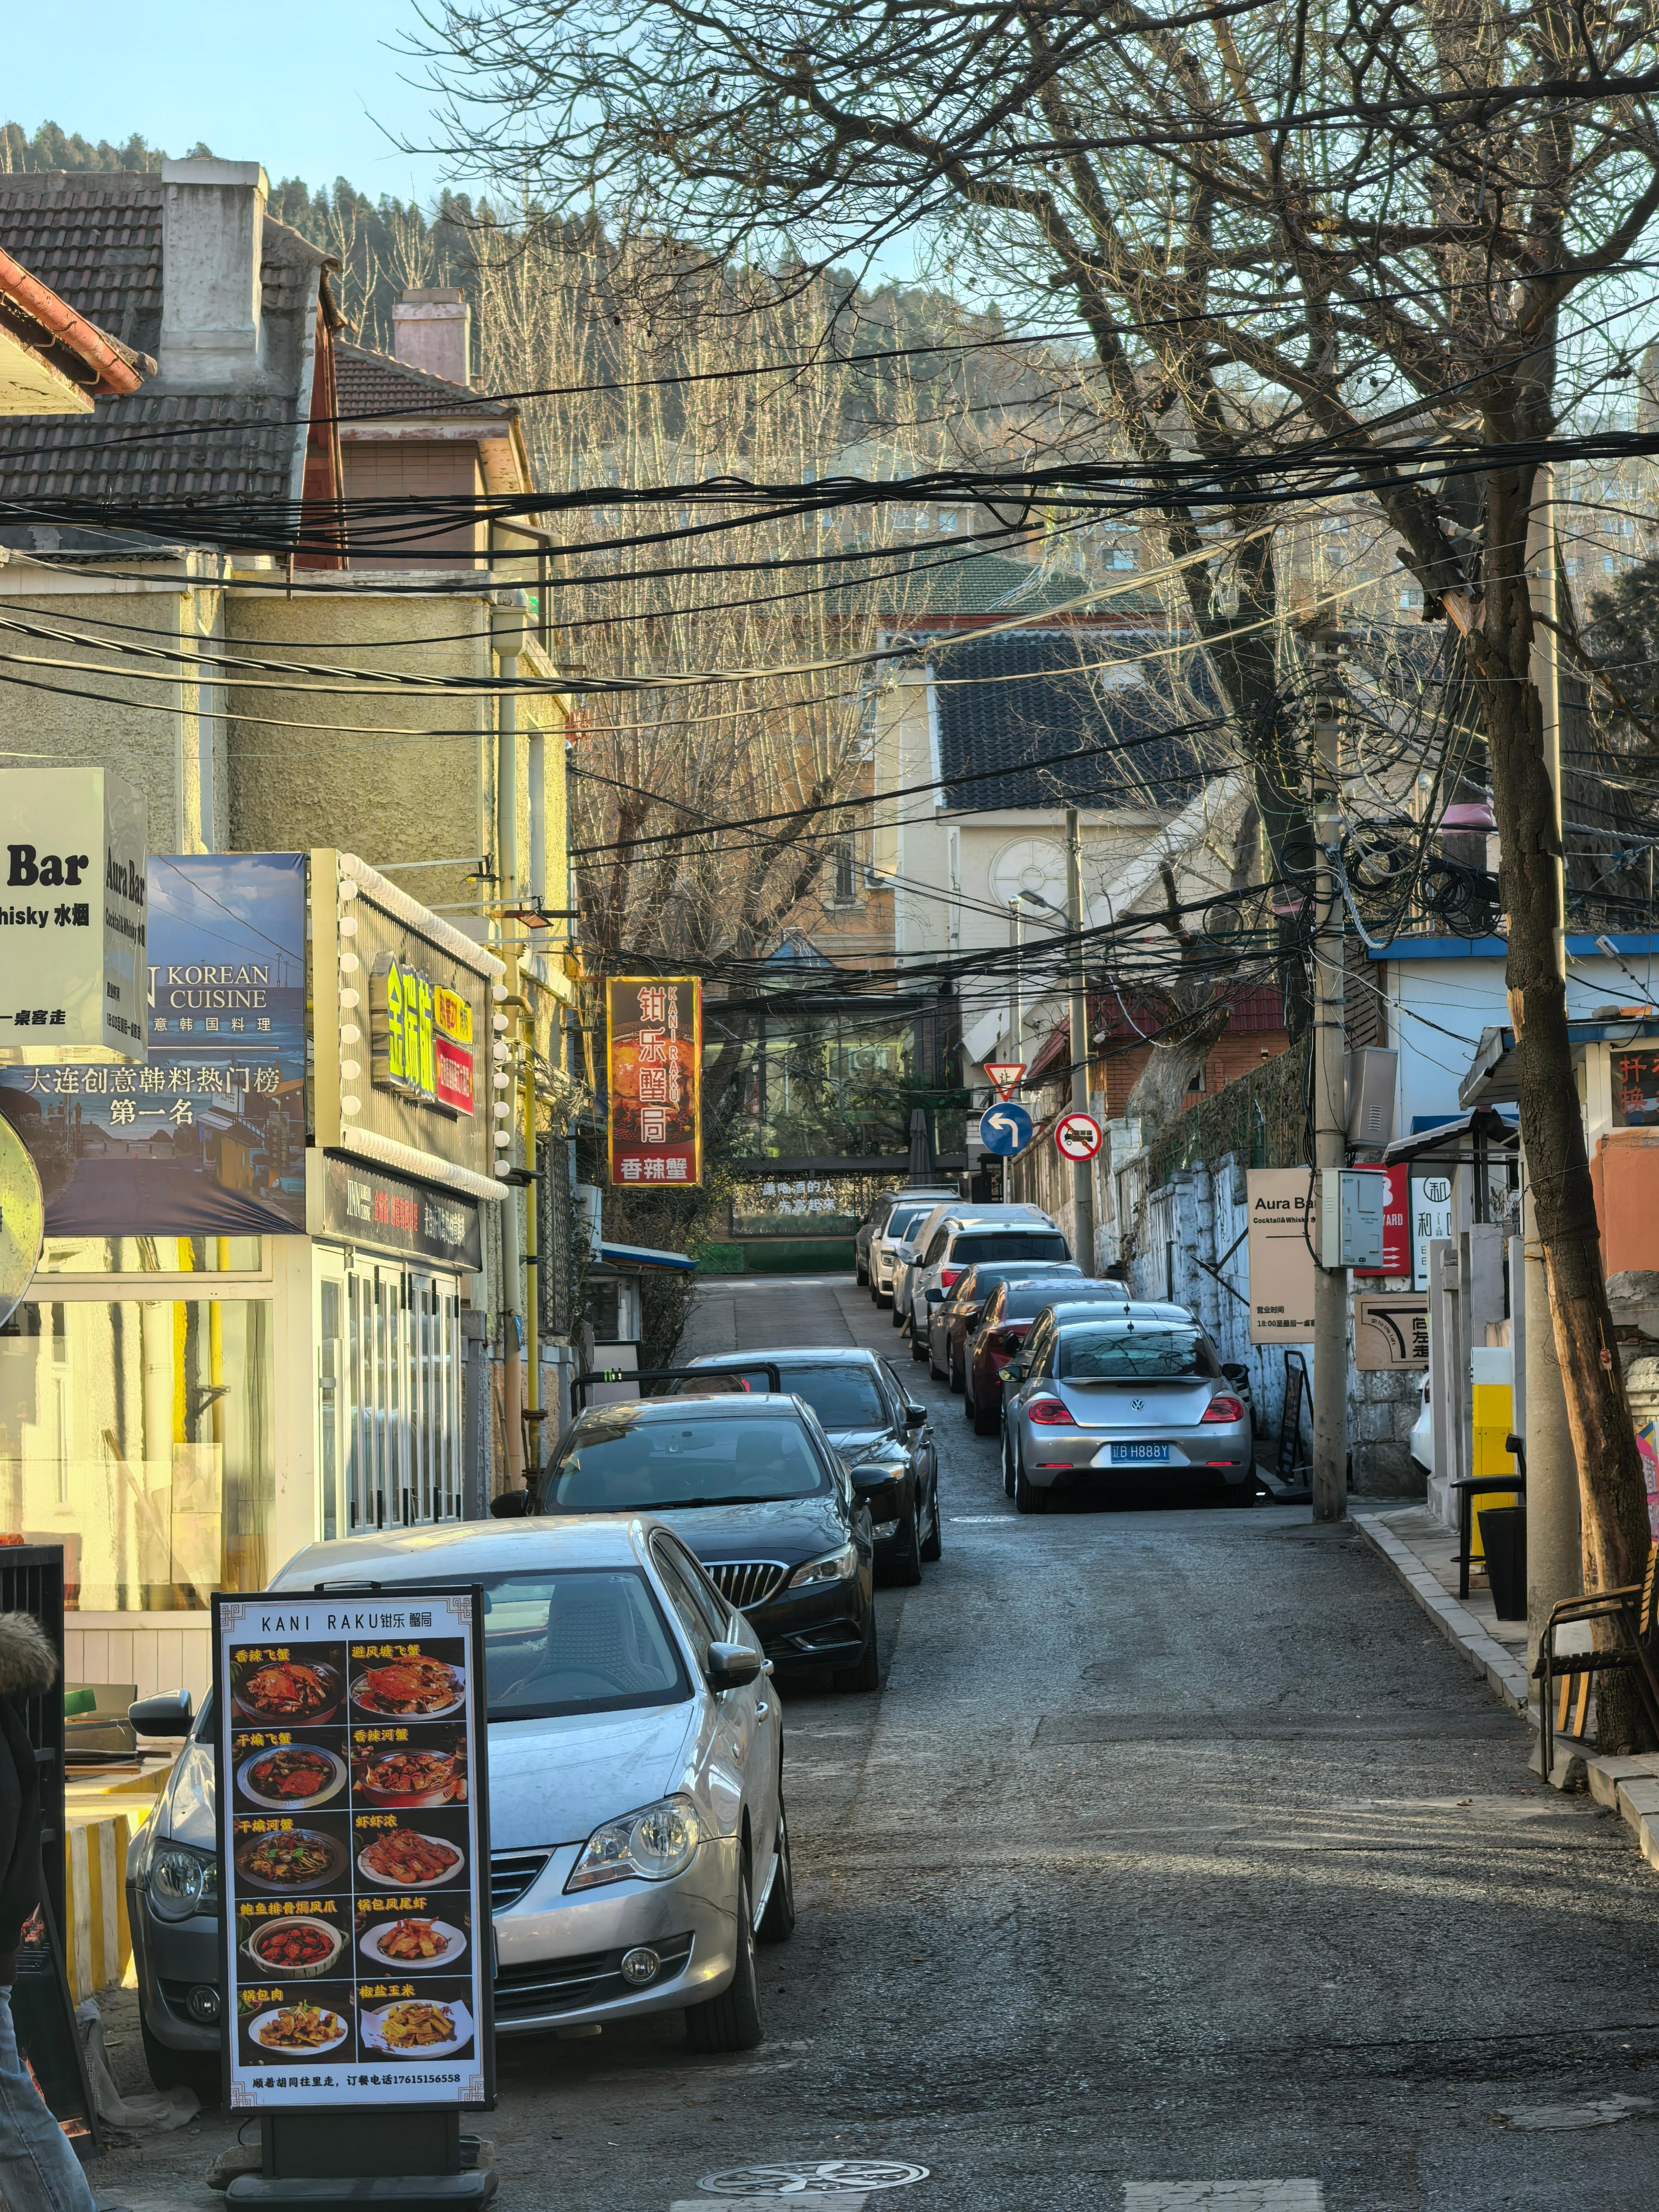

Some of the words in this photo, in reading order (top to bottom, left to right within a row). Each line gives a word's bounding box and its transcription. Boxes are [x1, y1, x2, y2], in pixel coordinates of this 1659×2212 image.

[7, 845, 89, 887] Bar
[106, 846, 127, 898] Aura
[129, 859, 144, 907] Bar
[166, 965, 269, 985] KOREAN
[170, 990, 267, 1009] CUISINE
[668, 986, 678, 1043] KANI
[637, 986, 667, 1144] 钳乐蟹局
[669, 1046, 680, 1103] RAKU
[24, 1066, 280, 1094] 大连创意韩料热门榜
[109, 1099, 194, 1126] 第一名
[621, 1158, 687, 1179] 香辣蟹
[1255, 1198, 1290, 1209] Aura
[262, 1615, 309, 1632] KANI
[328, 1613, 378, 1630] RAKU
[235, 1647, 290, 1663] 香辣飞蟹
[351, 1643, 421, 1659] 避风塘飞蟹
[354, 1728, 409, 1743] 香辣河蟹
[355, 1814, 397, 1828] 虾虾浓
[357, 1897, 428, 1912] 锅包凤尾虾
[242, 1988, 283, 2002] 锅包肉
[359, 1984, 416, 1999] 椒盐玉米
